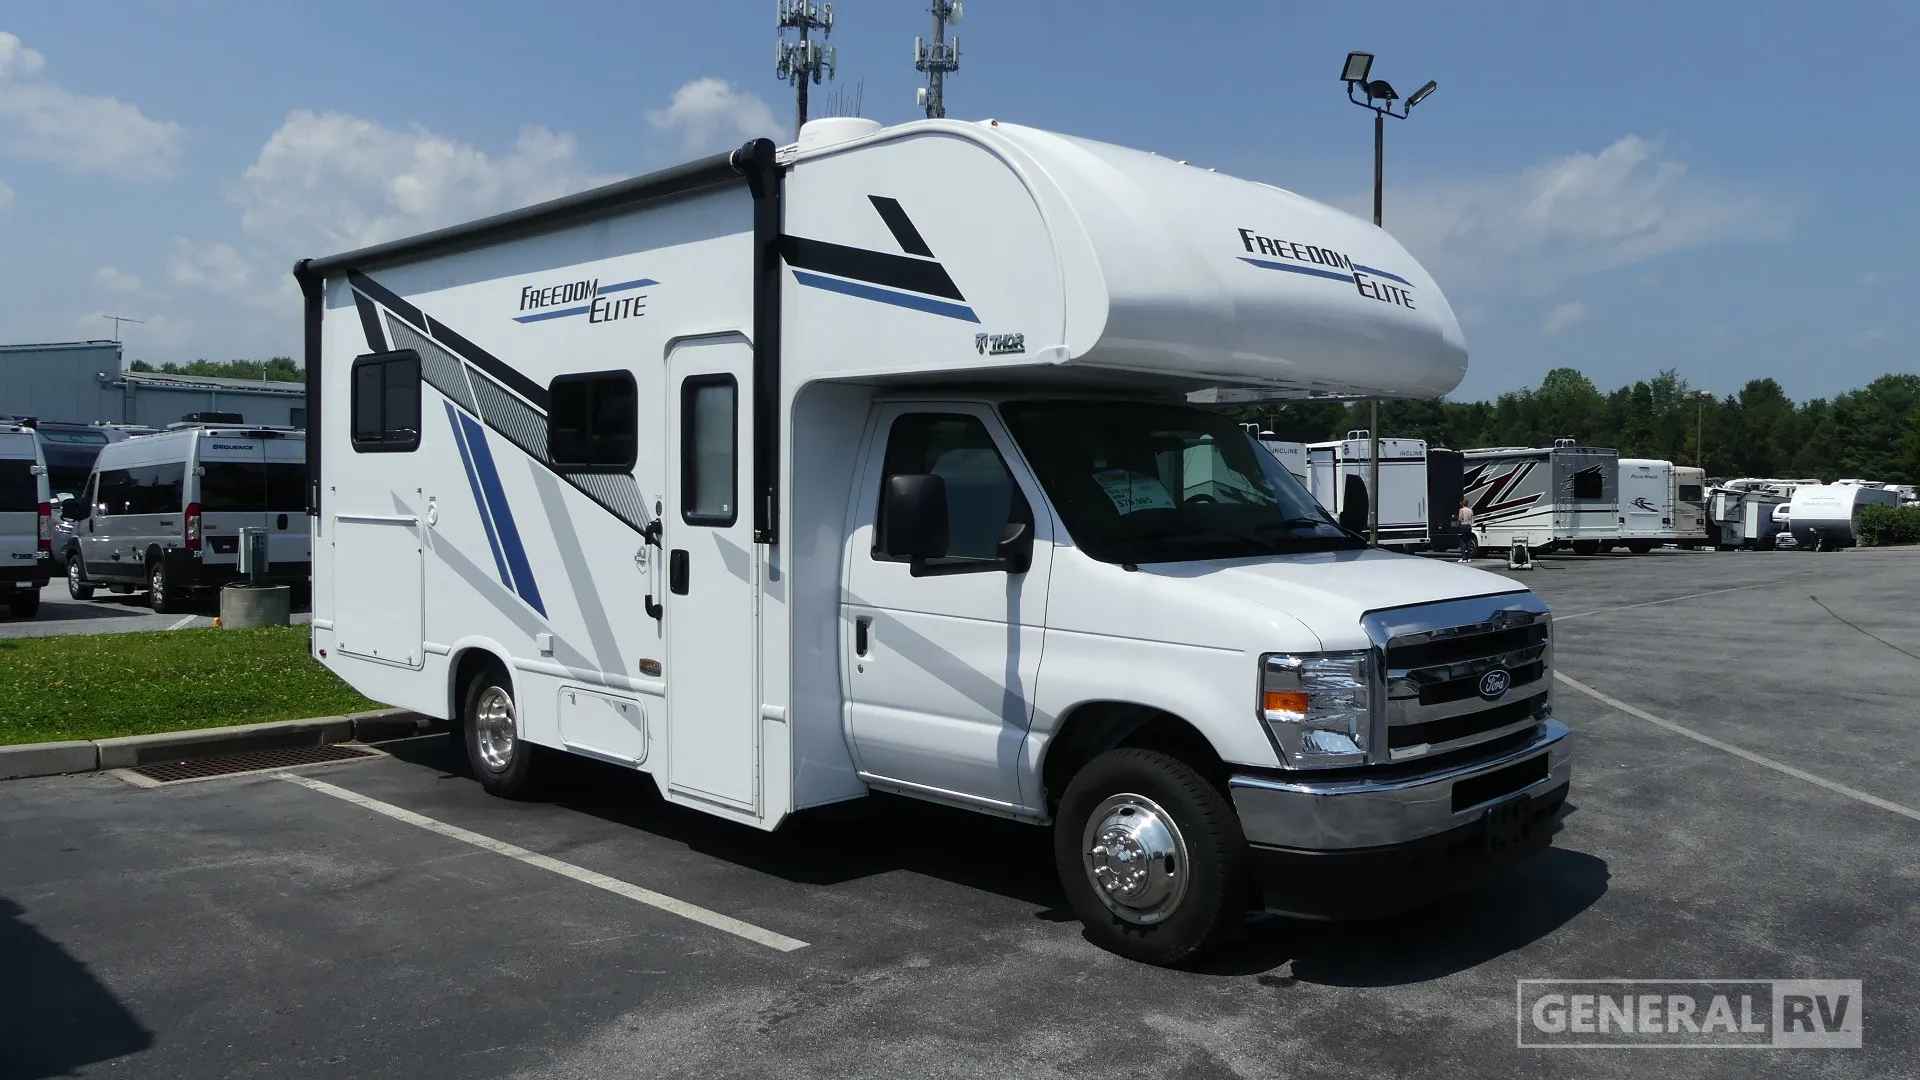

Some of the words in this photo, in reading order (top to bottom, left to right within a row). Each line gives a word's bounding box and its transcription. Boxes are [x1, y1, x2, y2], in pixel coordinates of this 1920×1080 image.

[1237, 228, 1355, 272] FREEDOM
[519, 278, 599, 311] FREEDOM
[1353, 272, 1416, 310] ELITE
[589, 295, 648, 324] ELITE
[988, 333, 1025, 351] THOR
[212, 443, 254, 451] SEQUENCE
[1271, 447, 1298, 455] INCLINE
[1485, 673, 1505, 692] Ford
